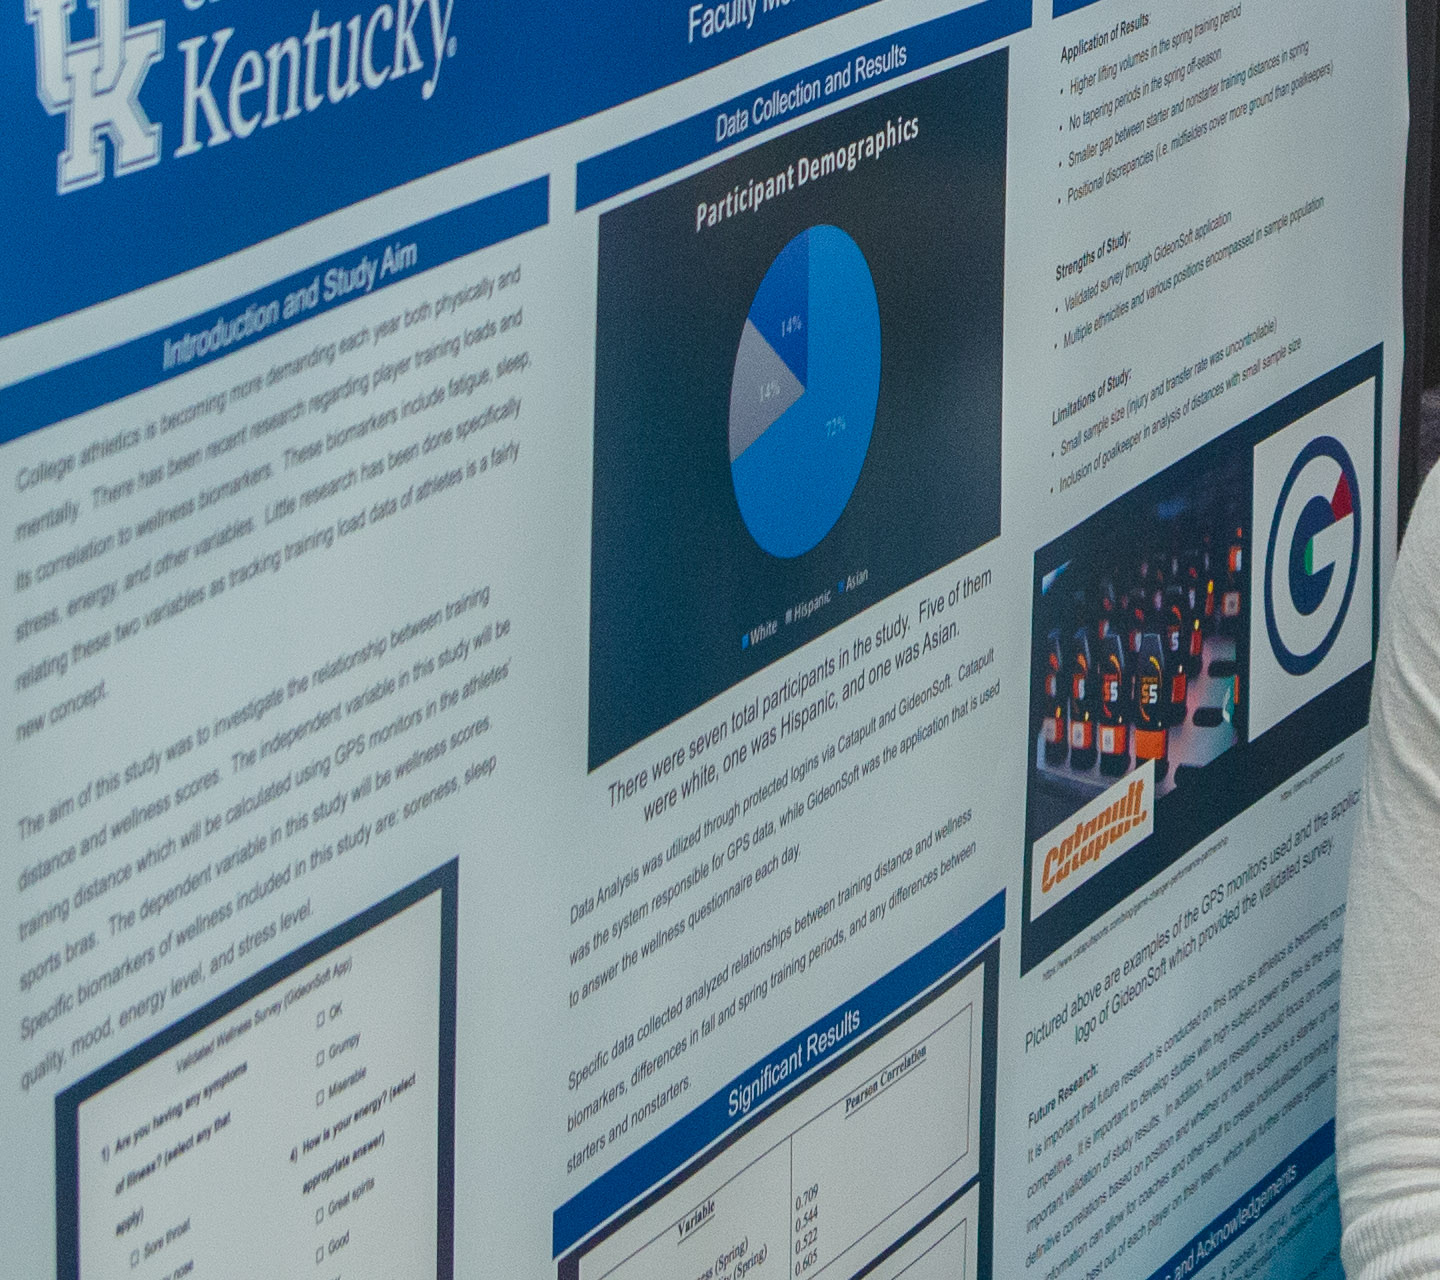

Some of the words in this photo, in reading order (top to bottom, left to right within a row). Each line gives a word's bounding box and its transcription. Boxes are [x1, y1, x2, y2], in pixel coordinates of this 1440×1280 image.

[715, 108, 750, 143] Data
[752, 76, 821, 124] Collection
[824, 62, 853, 97] and
[854, 43, 908, 84] Results
[696, 164, 795, 233] Participant
[797, 115, 919, 187] Demographics
[162, 299, 281, 370] Introduction
[281, 275, 321, 320] and
[322, 255, 380, 302] Study
[377, 242, 422, 291] Aim
[607, 769, 649, 808] There
[651, 746, 686, 782] were
[688, 720, 728, 761] seven
[730, 696, 760, 735] total
[762, 656, 836, 721] participants
[838, 648, 850, 671] in
[852, 635, 873, 662] the
[874, 613, 910, 649] study.
[918, 595, 946, 624] Five
[947, 579, 961, 608] of
[962, 568, 992, 600] them
[727, 1043, 803, 1118] Significant
[806, 1009, 861, 1062] Results
